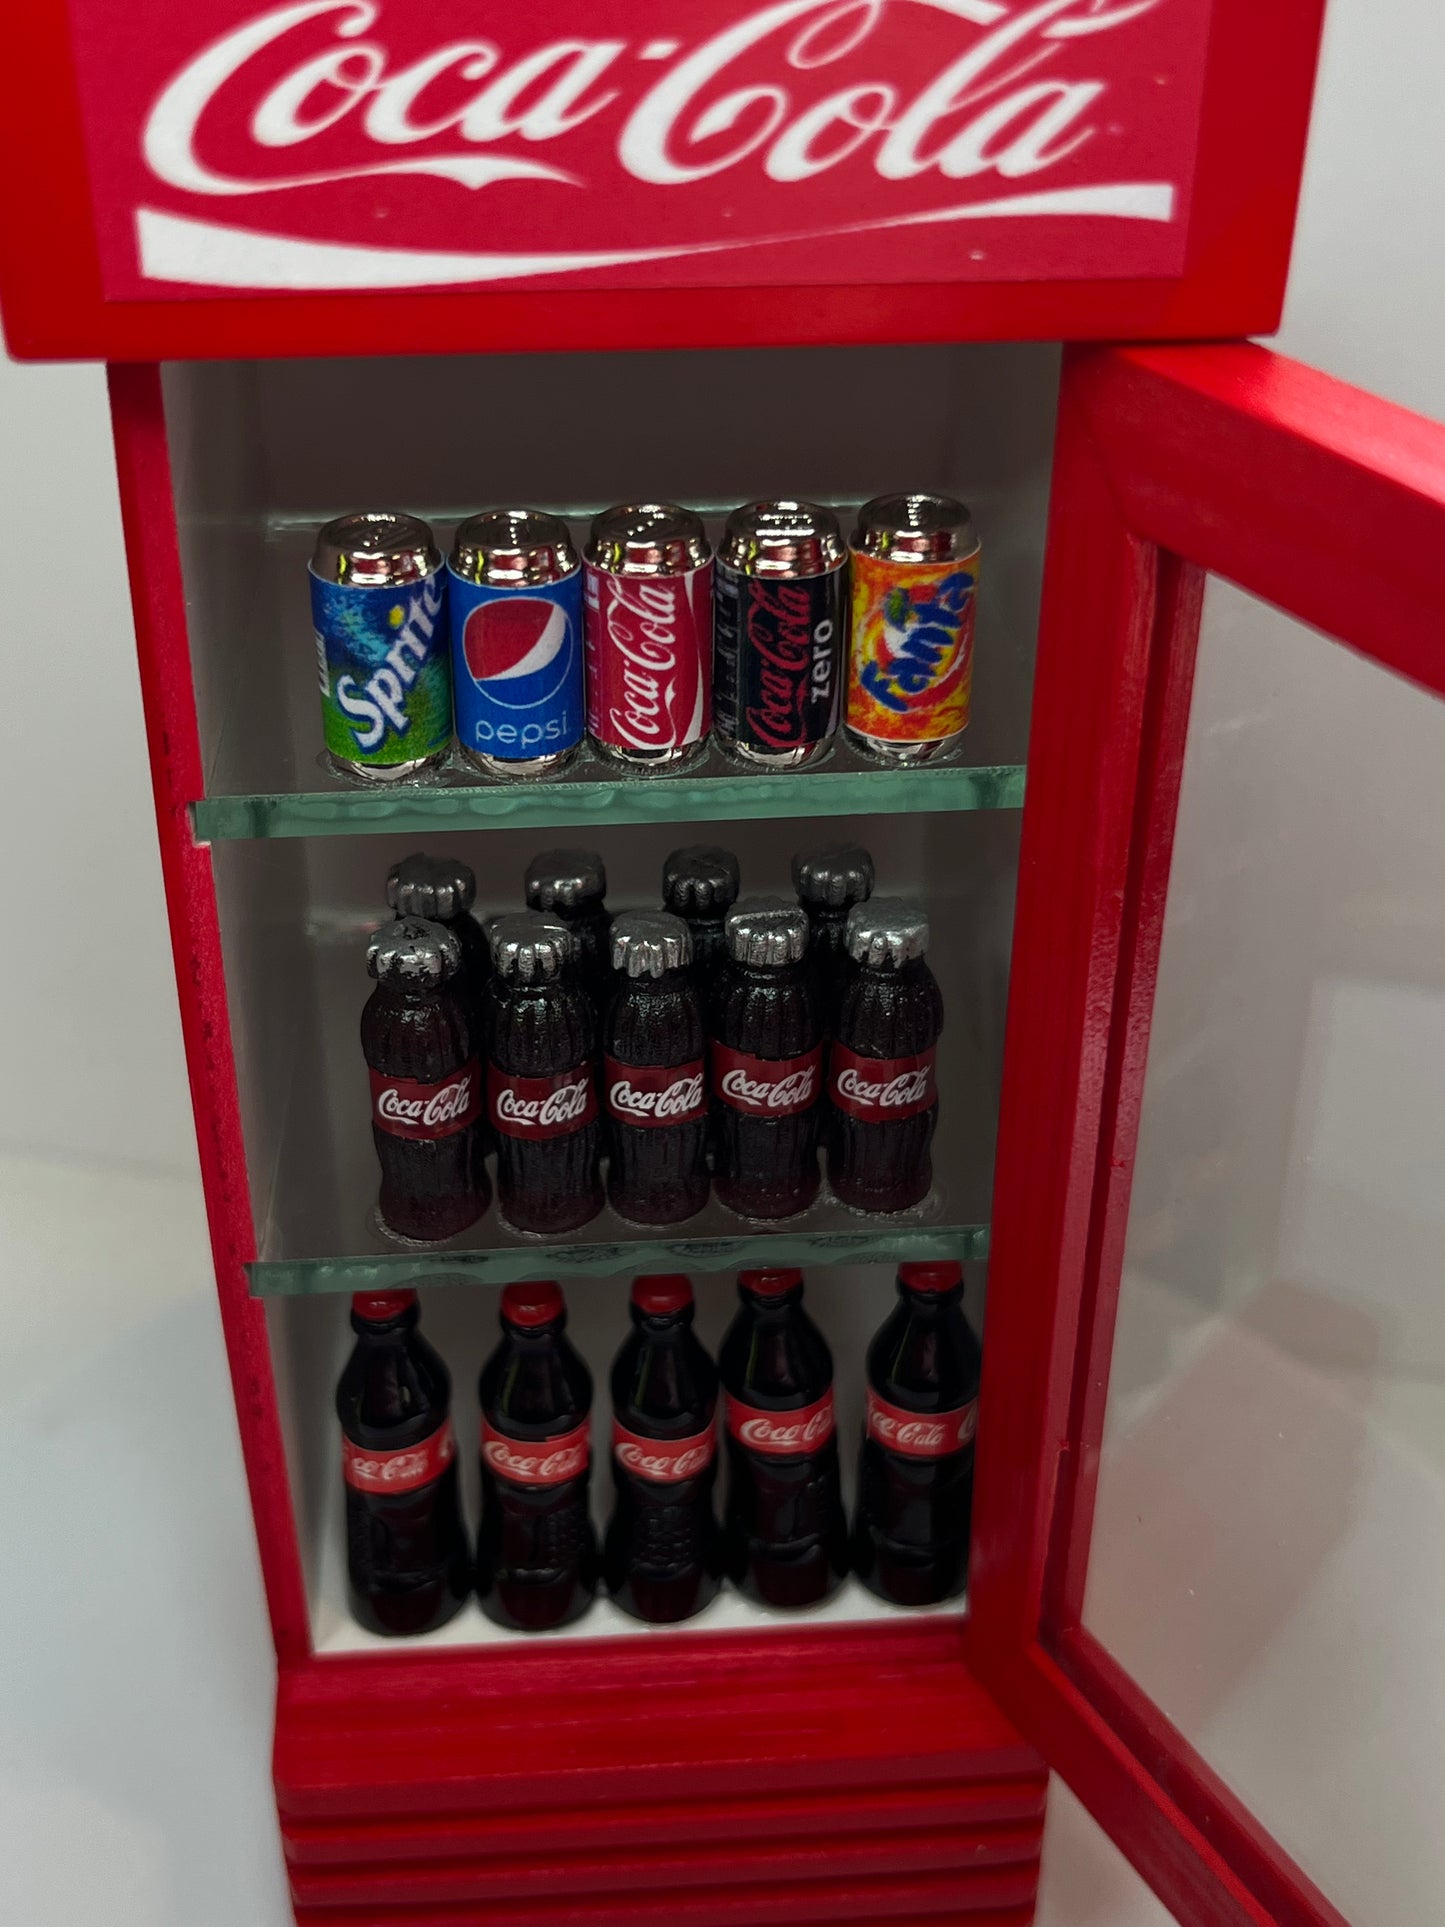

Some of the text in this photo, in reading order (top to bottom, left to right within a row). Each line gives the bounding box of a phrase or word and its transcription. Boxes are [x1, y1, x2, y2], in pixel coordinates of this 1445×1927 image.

[143, 0, 1160, 194] Coca-Cola
[337, 575, 443, 748] Sprite
[607, 573, 677, 750] Coca-Cola
[745, 578, 811, 749] Coca-Cola
[811, 618, 834, 704] zero
[860, 572, 975, 712] Fanta
[475, 710, 568, 746] pepsi
[378, 1074, 472, 1126] Coca-Cola
[497, 1076, 590, 1126] Coca-Cola
[610, 1072, 704, 1117] Coca-Cola
[722, 1065, 816, 1107] Coca-Cola
[837, 1065, 931, 1106] Coca-Cola
